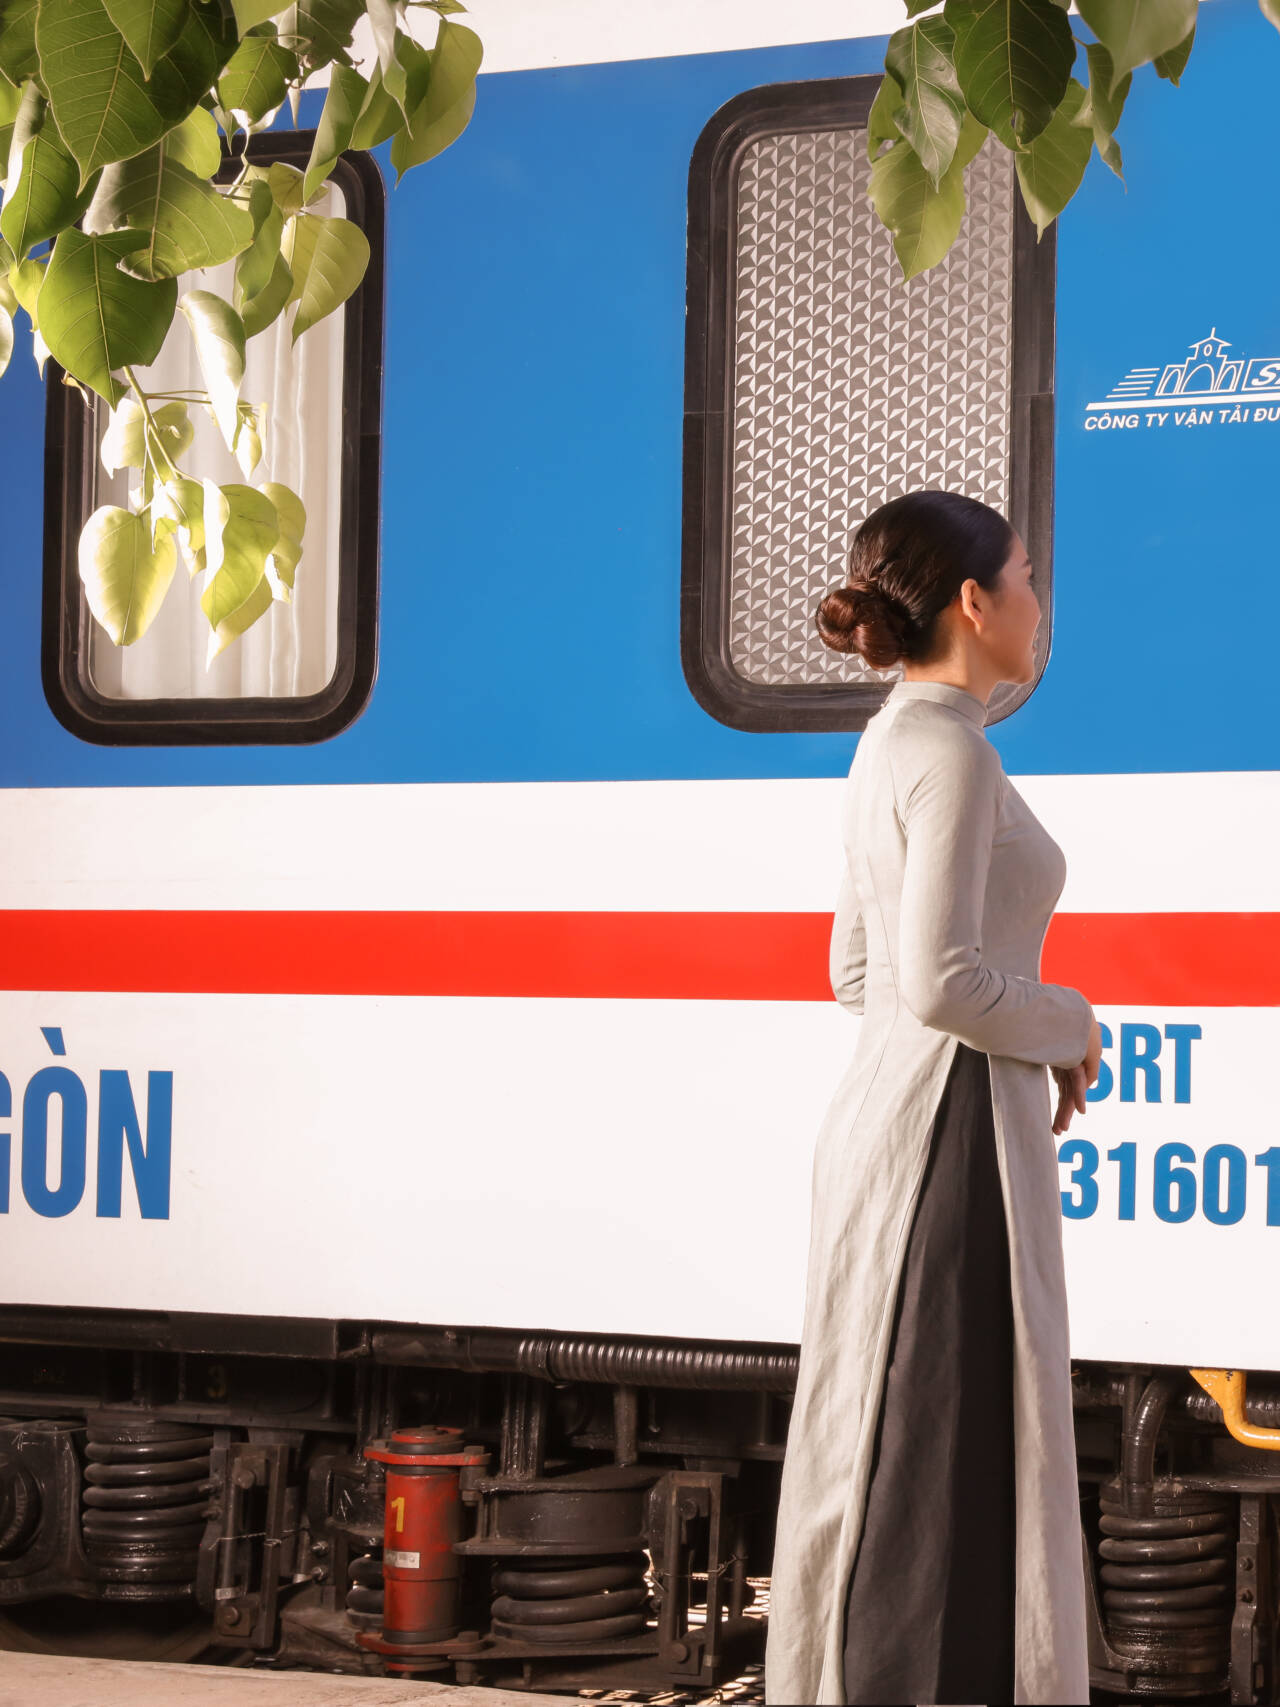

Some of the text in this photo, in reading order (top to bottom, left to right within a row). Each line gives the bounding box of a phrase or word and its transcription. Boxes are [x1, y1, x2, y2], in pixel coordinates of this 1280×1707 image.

[1084, 412, 1140, 431] CÔNG
[1145, 412, 1169, 428] TY
[1174, 409, 1215, 428] VẬN
[1218, 404, 1250, 424] TẢI
[0, 1026, 174, 1220] ÒN
[391, 1496, 405, 1533] 1
